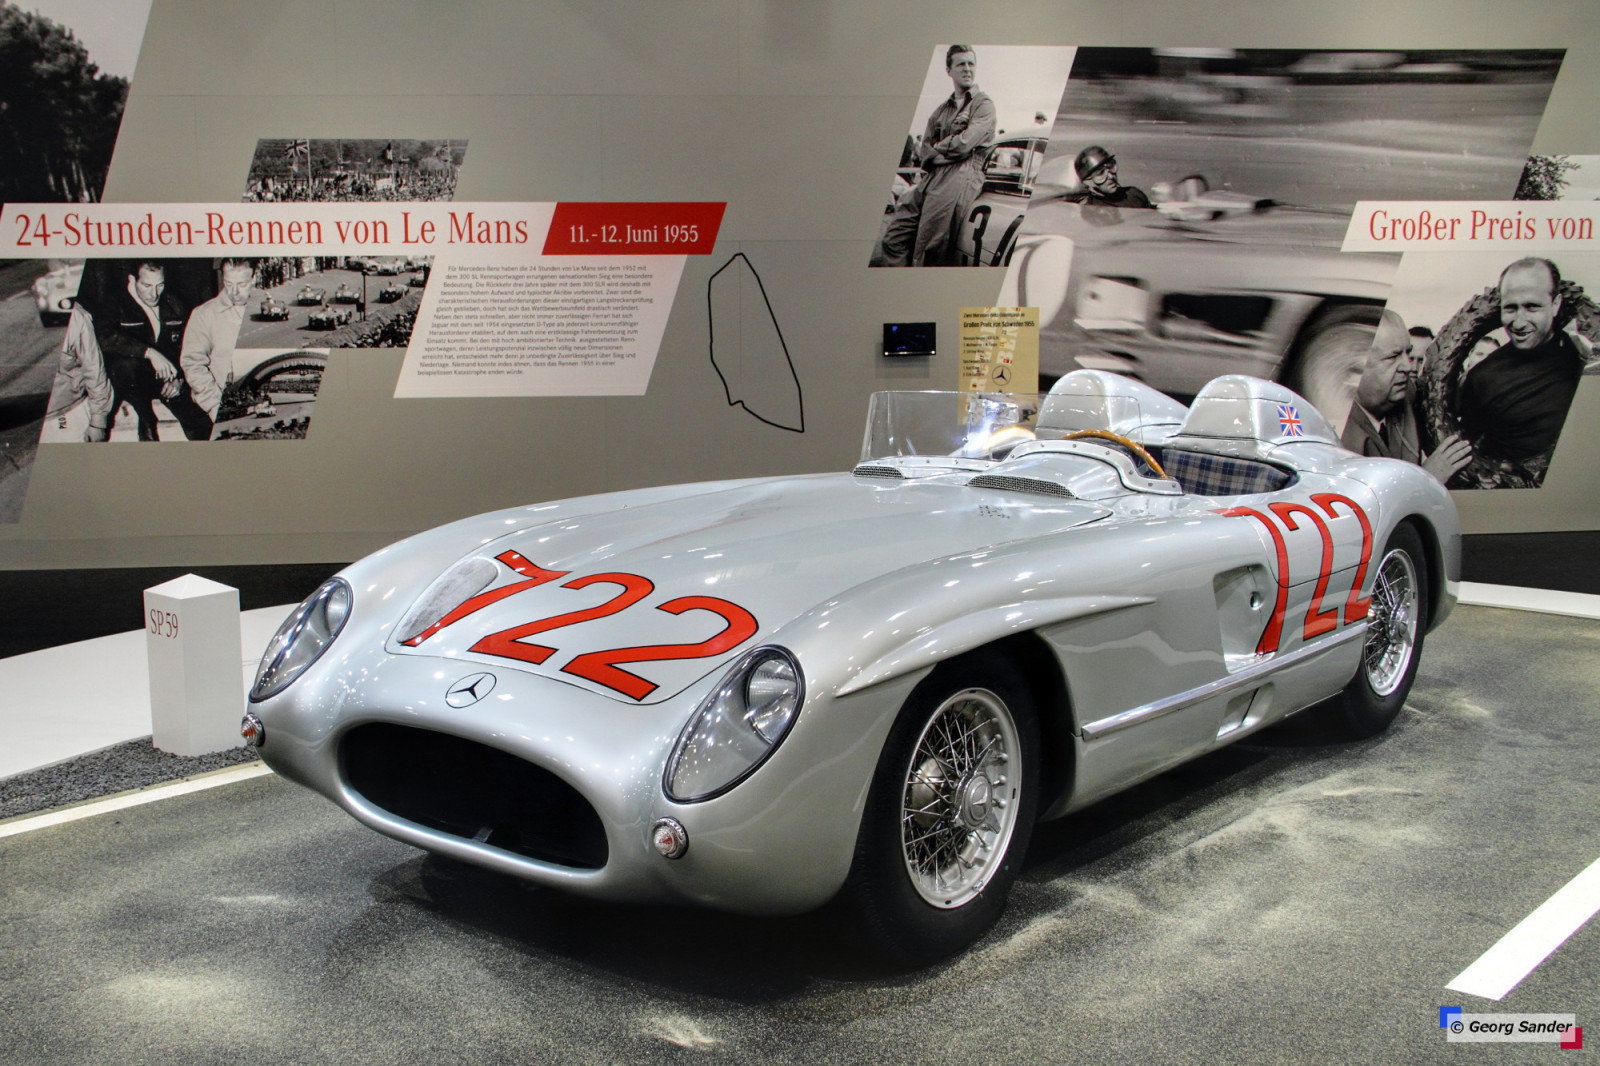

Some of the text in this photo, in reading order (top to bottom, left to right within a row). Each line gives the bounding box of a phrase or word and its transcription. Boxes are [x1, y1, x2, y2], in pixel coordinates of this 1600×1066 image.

[16, 212, 528, 246] 24-Stunden-Rennen von Le Mans
[626, 224, 658, 244] Juni
[664, 225, 698, 242] 1955
[1370, 210, 1594, 240] Großer Preis von
[1207, 493, 1373, 656] 722
[150, 608, 178, 639] SP 59
[400, 549, 759, 702] 722
